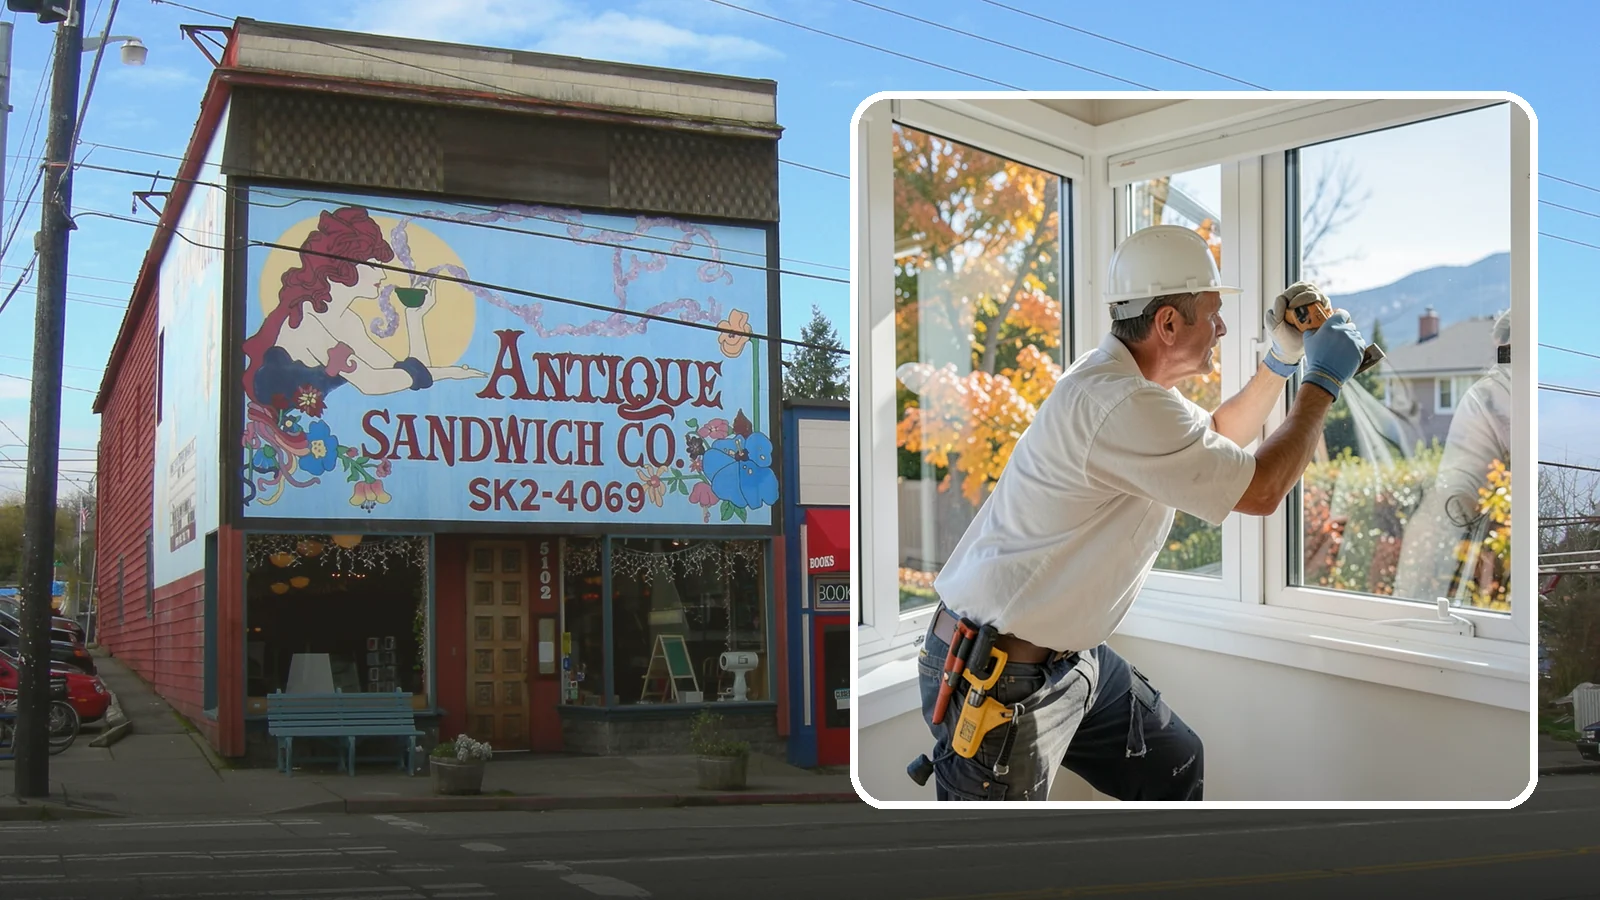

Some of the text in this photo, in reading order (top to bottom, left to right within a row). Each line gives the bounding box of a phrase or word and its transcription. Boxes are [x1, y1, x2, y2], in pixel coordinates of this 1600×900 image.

[476, 329, 723, 420] ANTIQUE
[361, 408, 684, 468] SANDWICH CO.
[468, 477, 645, 513] SK2-4069
[540, 542, 551, 599] 5102
[809, 555, 835, 569] BOOKS
